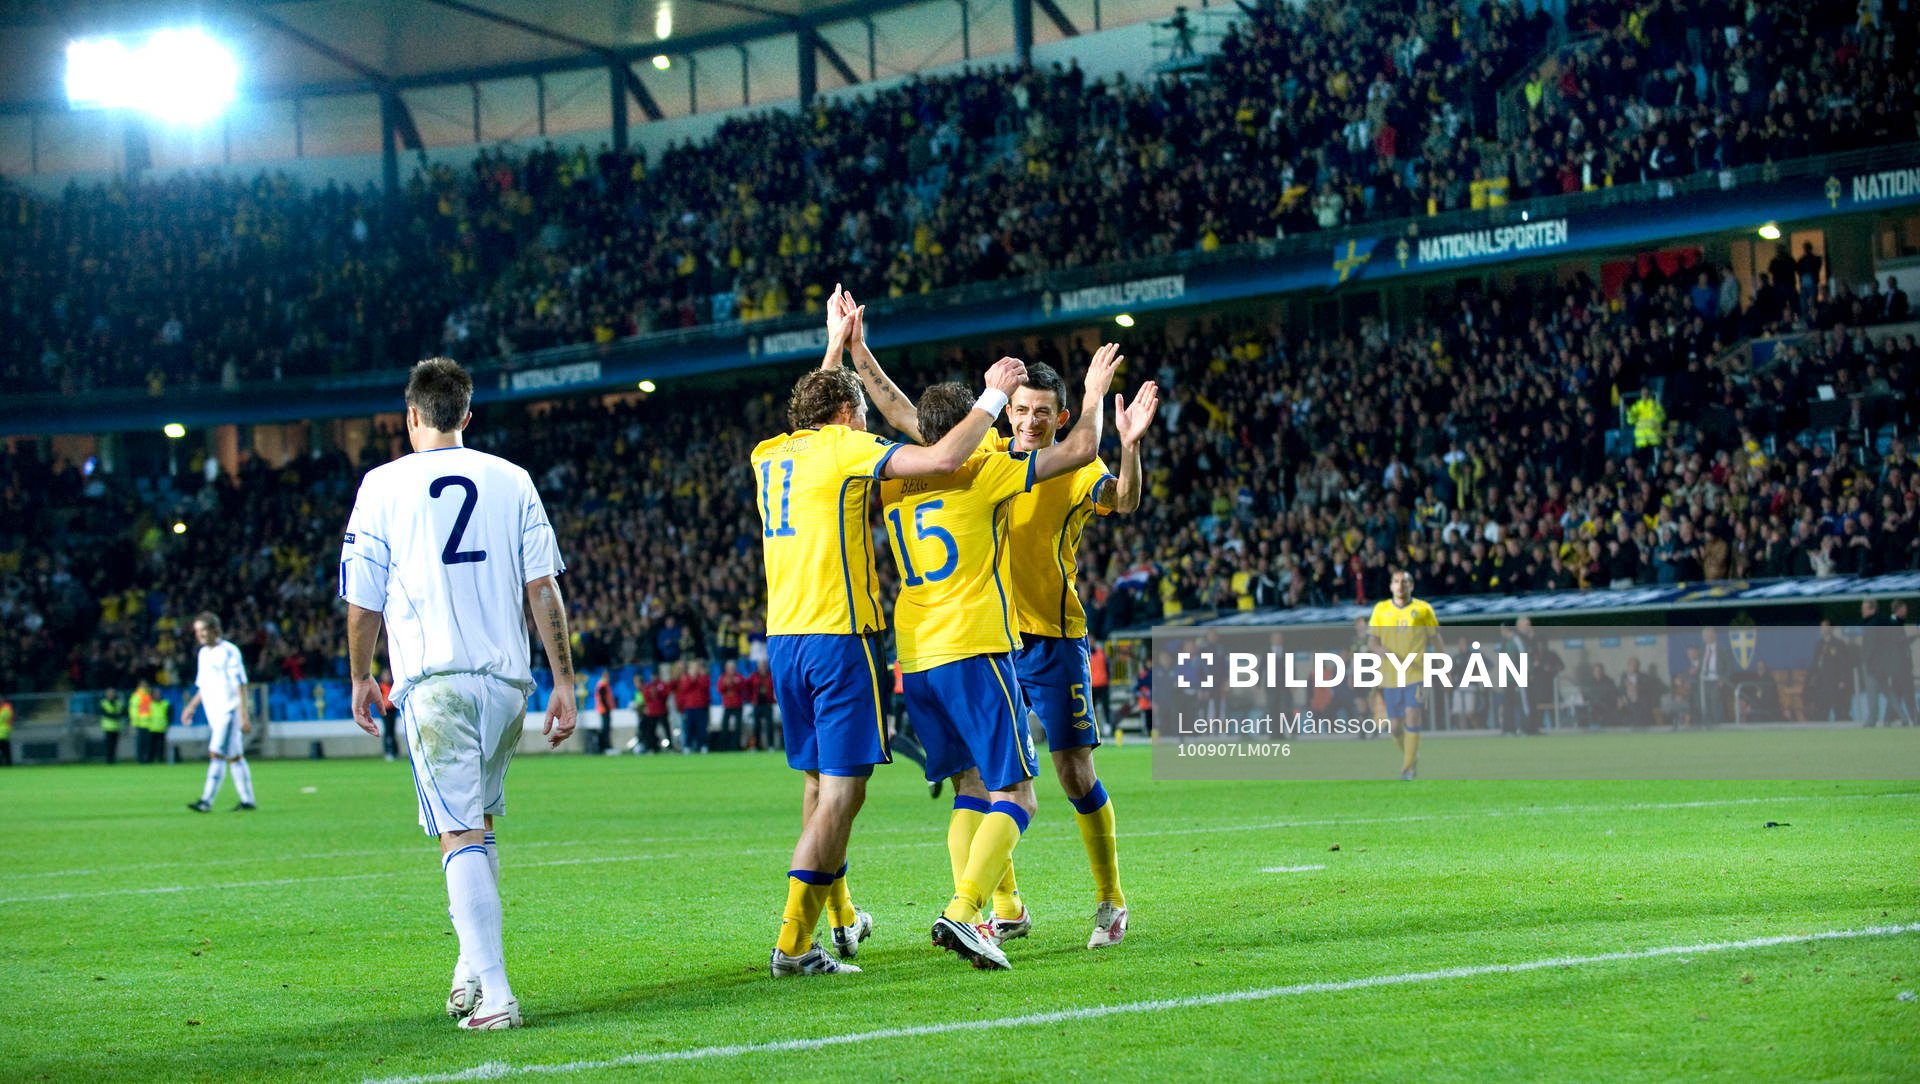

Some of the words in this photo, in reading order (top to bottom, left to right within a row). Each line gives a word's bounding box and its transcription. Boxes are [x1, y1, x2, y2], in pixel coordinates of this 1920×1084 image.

[1419, 218, 1567, 263] NATIONALSPORTEN
[1060, 274, 1184, 313] NATIONALSPORTEN
[429, 475, 487, 565] 2
[760, 458, 796, 537] 11
[888, 499, 958, 587] 15
[1071, 684, 1087, 717] 5
